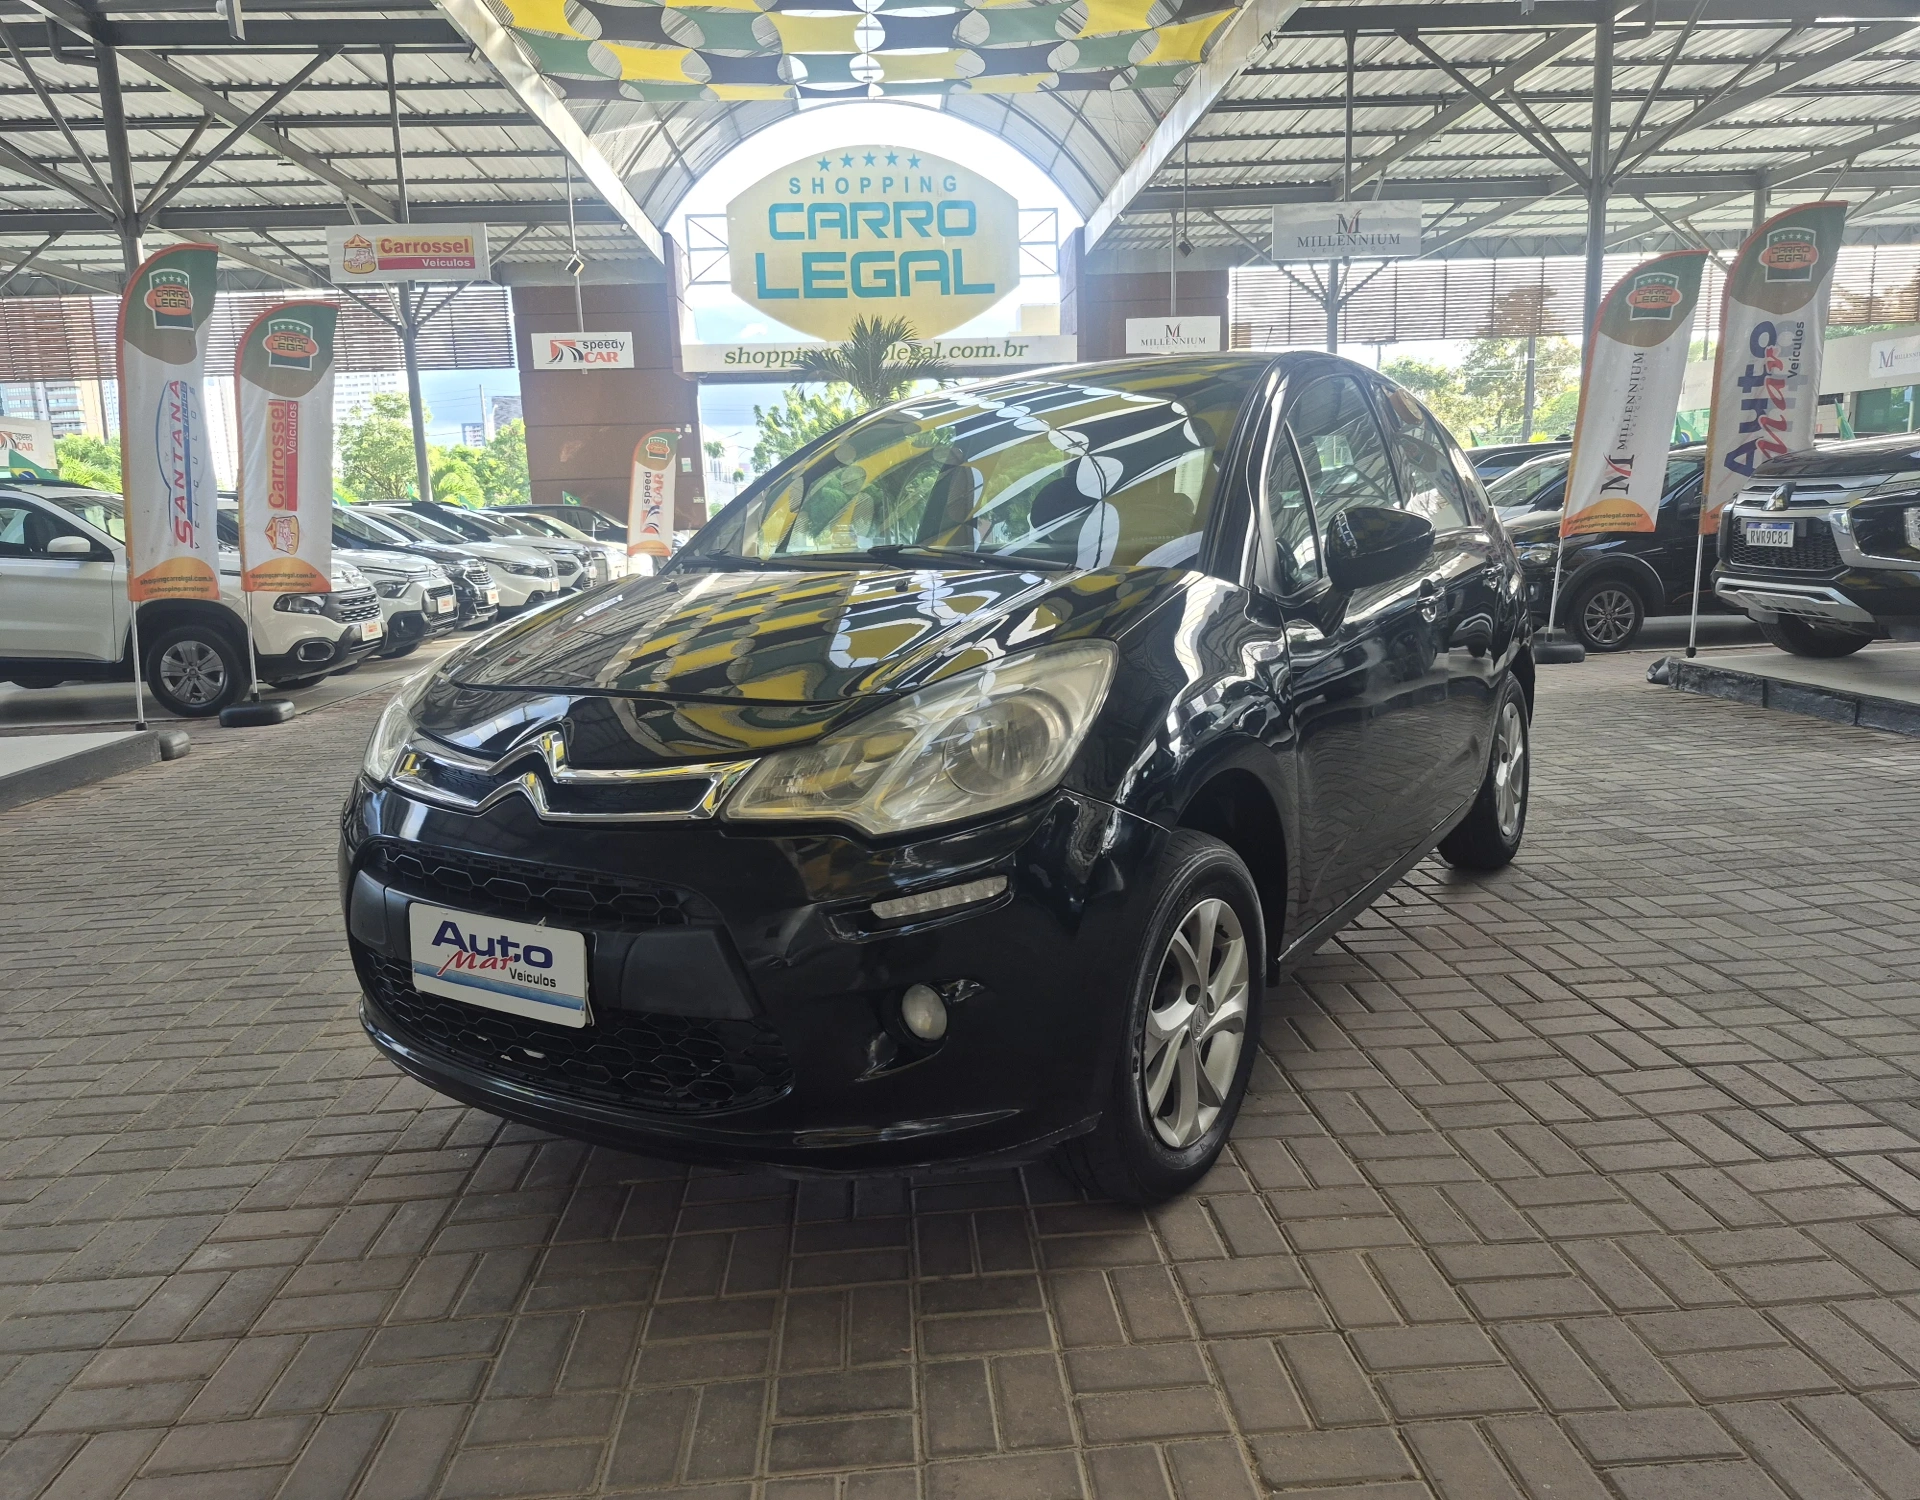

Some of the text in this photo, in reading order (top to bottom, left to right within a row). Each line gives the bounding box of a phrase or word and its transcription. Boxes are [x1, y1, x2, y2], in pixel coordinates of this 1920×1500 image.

[789, 175, 957, 195] SHOPPING
[769, 200, 976, 241] CARRO
[380, 238, 469, 254] Carrossel
[1297, 233, 1401, 248] MILLENNIUM
[1771, 246, 1810, 254] CARRO
[1769, 254, 1812, 264] LEGAL
[755, 248, 995, 300] LEGAL
[155, 290, 190, 299] CARRO
[1634, 295, 1674, 304] LEGAL
[1637, 288, 1673, 296] CARRO
[154, 298, 192, 309] LEGAL
[271, 342, 311, 353] LEGAL
[273, 335, 309, 345] CARRO
[582, 339, 625, 351] speedy
[1140, 337, 1206, 346] MILLENNIUM
[584, 351, 619, 363] CAR
[1787, 321, 1805, 379] Veículos
[1617, 352, 1645, 450] MILLENNIUM
[1724, 320, 1777, 478] Auto
[287, 403, 298, 455] Veículos
[16, 442, 34, 451] CAR
[268, 401, 285, 509] Carrossel
[168, 380, 193, 549] SANTANA
[431, 920, 553, 969] Auto
[436, 950, 514, 977] Mar
[509, 967, 556, 988] Veículos
